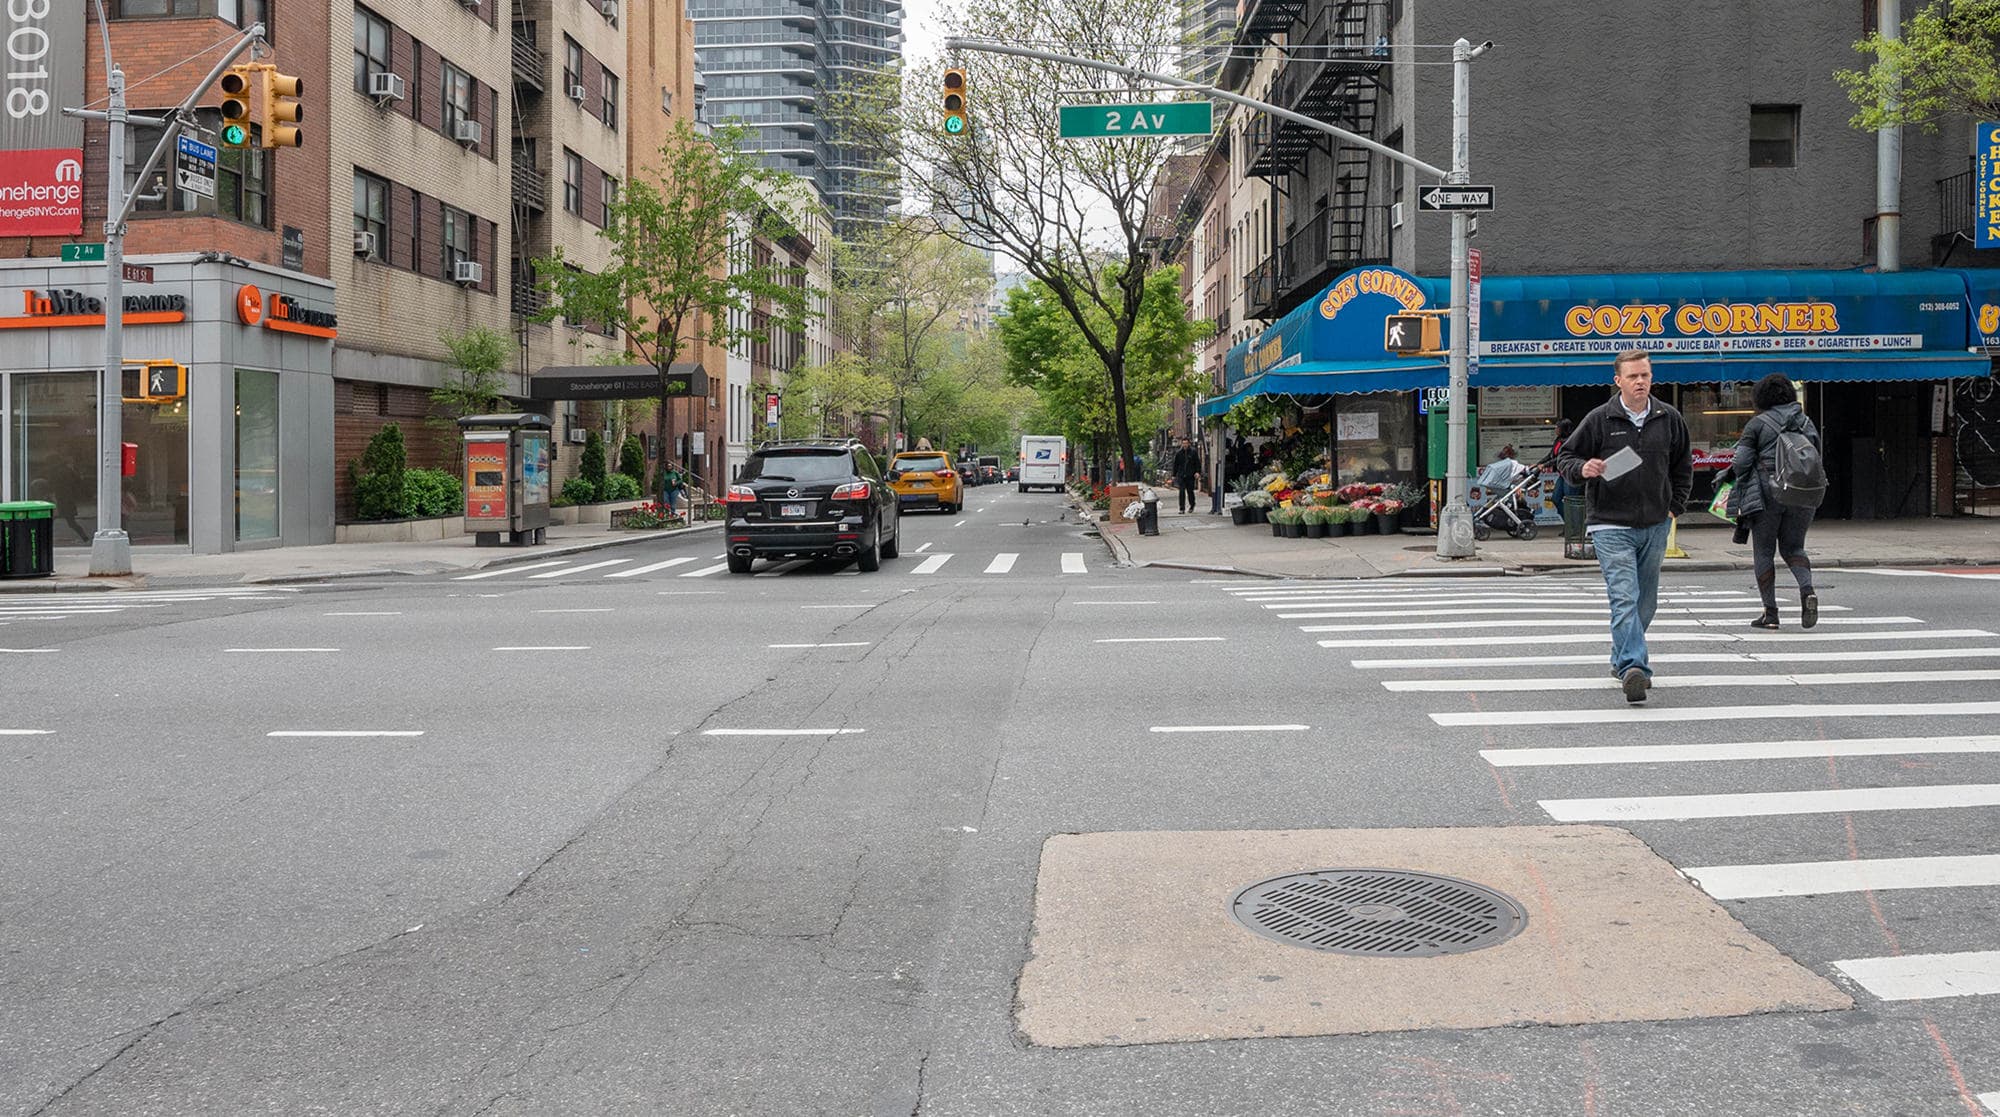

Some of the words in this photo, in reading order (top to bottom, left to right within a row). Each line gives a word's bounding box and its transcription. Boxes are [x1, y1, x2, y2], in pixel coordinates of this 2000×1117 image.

[1105, 110, 1121, 131] 2
[1130, 110, 1166, 130] Av
[0, 181, 80, 204] nehenge
[1430, 193, 1452, 204] ONE
[1461, 193, 1484, 204] WAY
[1979, 180, 1987, 218] CORNER
[73, 246, 80, 260] 2
[126, 267, 132, 279] E
[132, 269, 140, 281] 61
[1320, 273, 1358, 320] COZY
[1358, 269, 1426, 311] CORNER
[1565, 304, 1671, 337] COZY
[1675, 302, 1841, 335] CORNER
[1490, 342, 1541, 353] BREAKFAST
[1552, 341, 1585, 352] CREATE
[1588, 341, 1613, 351] YOUR
[1614, 340, 1634, 351] OWN
[1636, 340, 1664, 351] SALAD
[1675, 340, 1701, 350] JUICE
[1703, 339, 1720, 350] BAR
[1732, 338, 1772, 349] FLOWERS
[1784, 337, 1806, 348] BEER
[1817, 337, 1871, 348] CIGARETTES
[1882, 336, 1912, 347] LUNCH
[569, 381, 613, 391] Stonehenge
[614, 382, 622, 390] 61
[470, 485, 502, 493] MILLION
